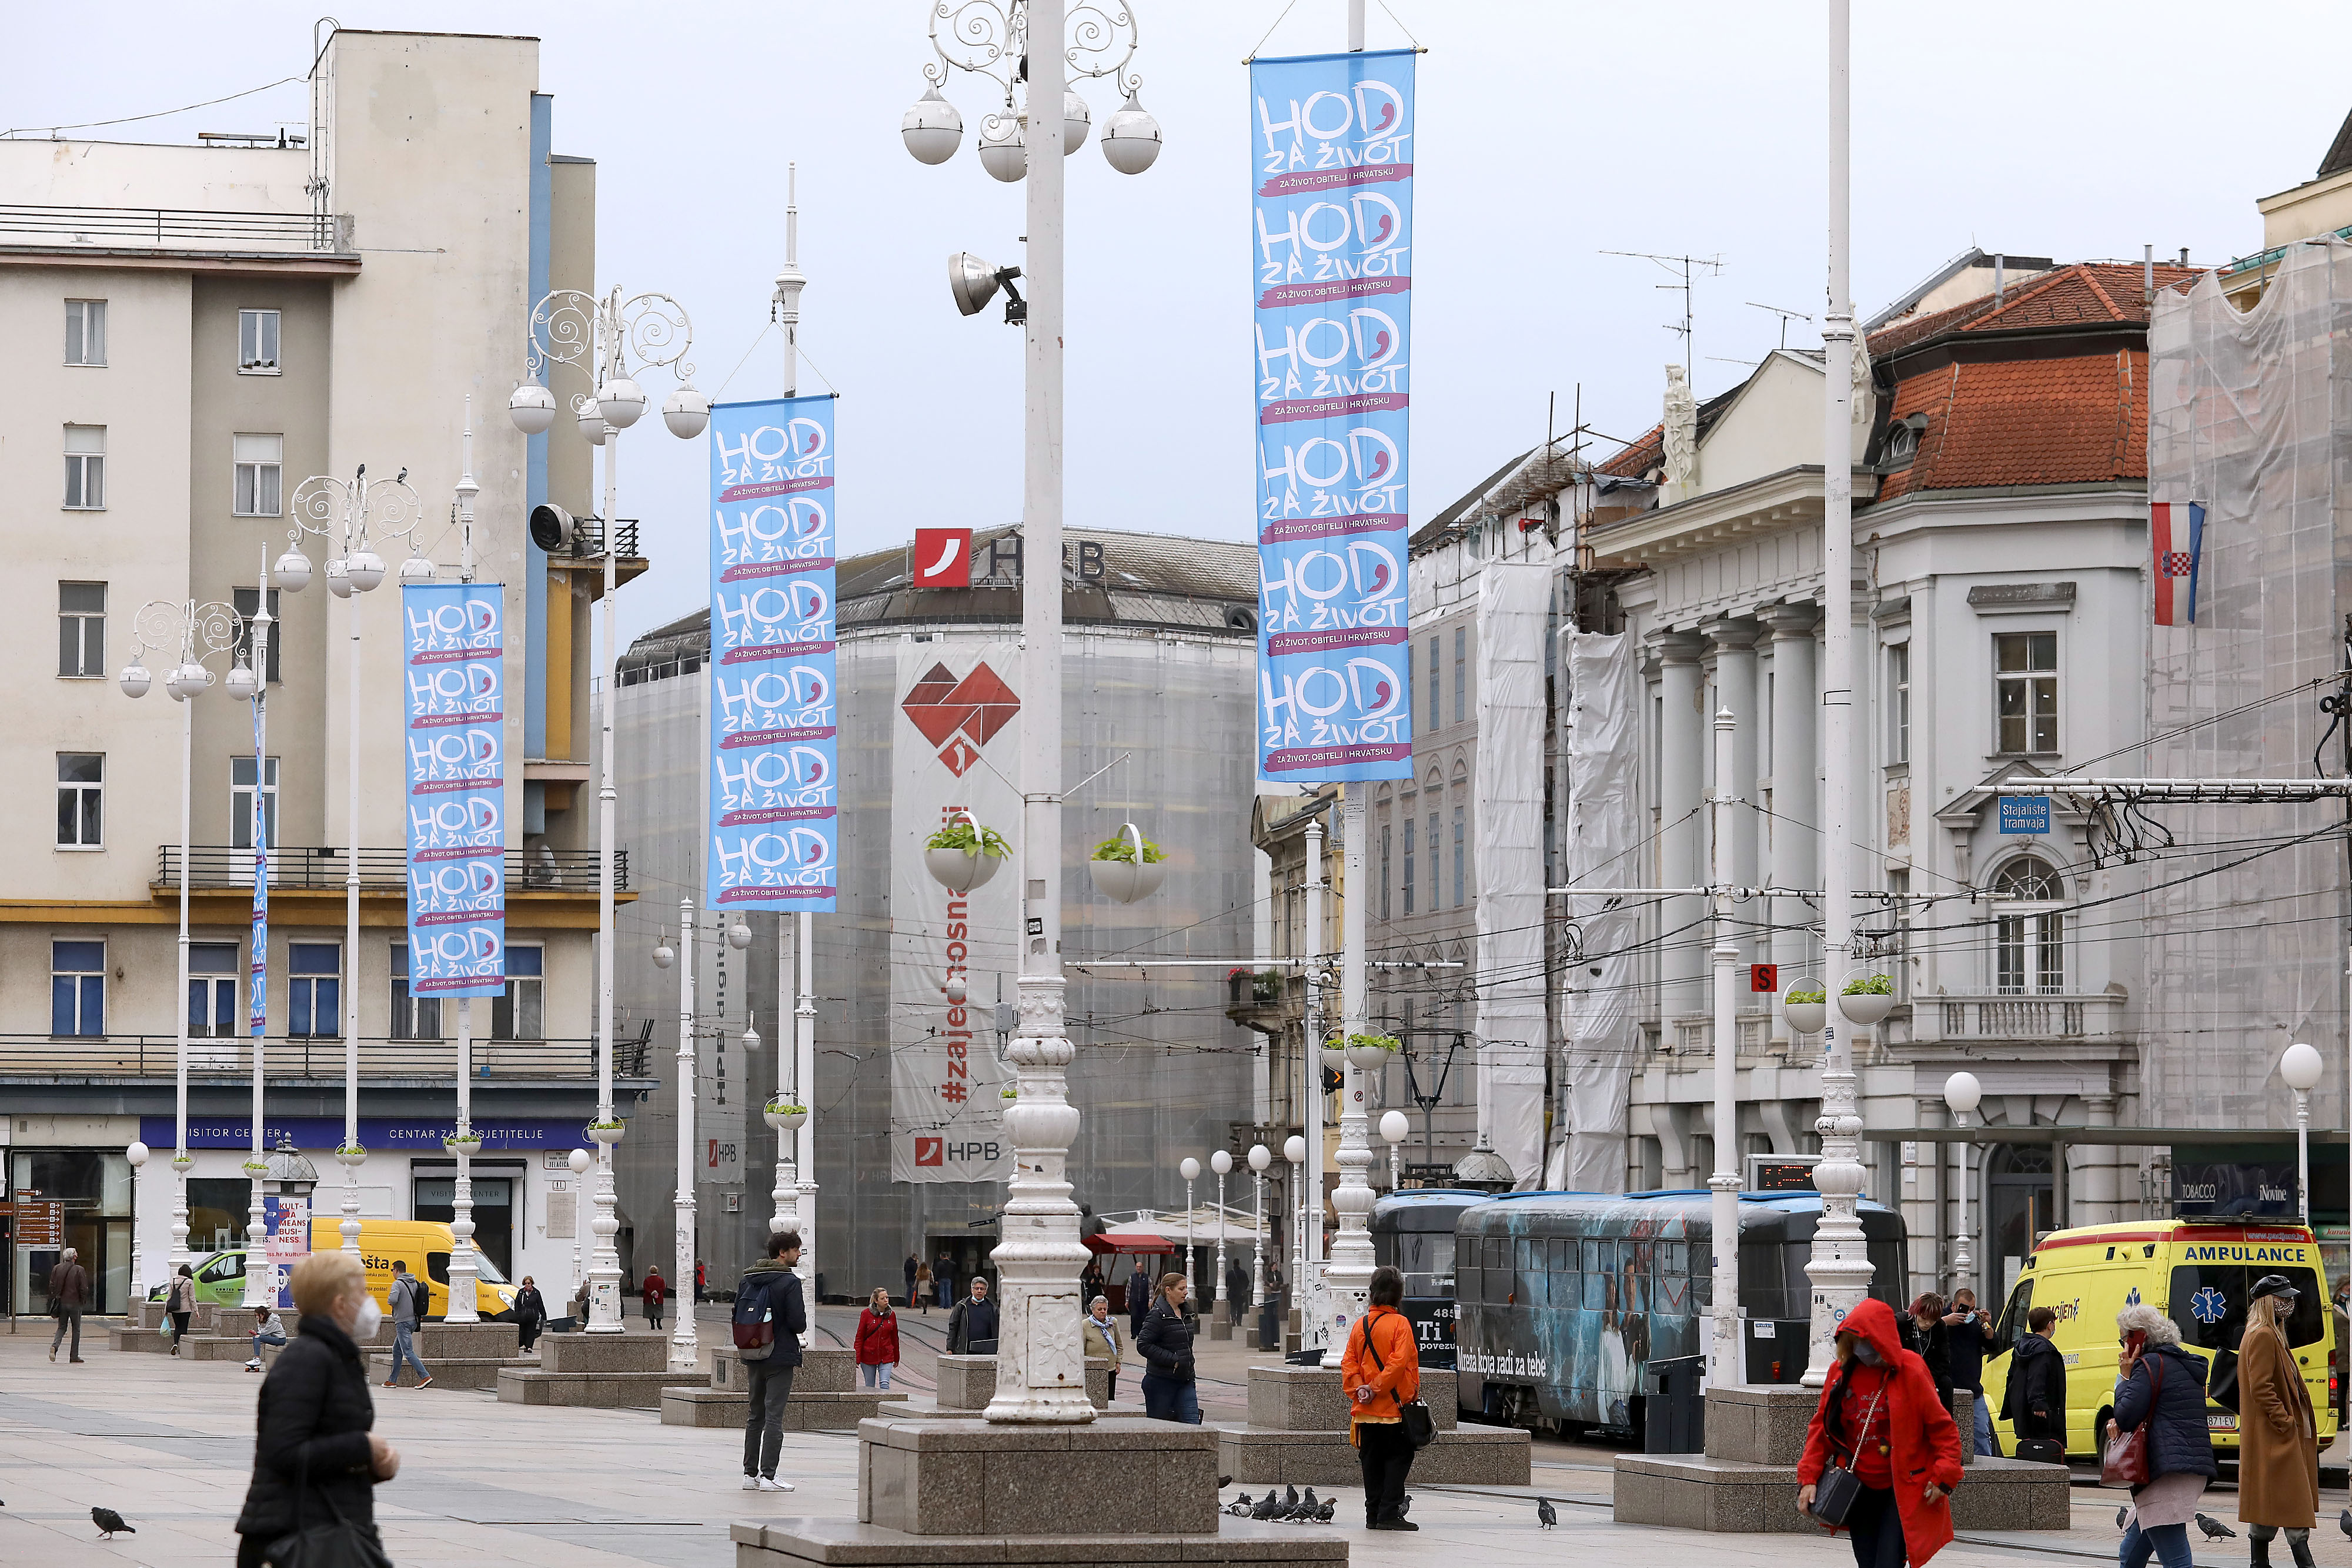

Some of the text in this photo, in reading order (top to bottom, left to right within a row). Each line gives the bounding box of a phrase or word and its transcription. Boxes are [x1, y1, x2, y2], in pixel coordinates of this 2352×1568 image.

[1258, 80, 1404, 151] HOD
[1263, 133, 1412, 173] ZA ŽIVOT
[1316, 173, 1347, 183] OBITELJ
[1353, 168, 1394, 179] HRVATSKU
[1256, 192, 1402, 263] HOD
[1258, 247, 1411, 285] ZA ŽIVOT
[1314, 285, 1345, 296] OBITELJ
[1351, 280, 1391, 292] HRVATSKU
[1255, 307, 1400, 378] HOD
[1259, 363, 1408, 400] ZA ŽIVOT
[1312, 402, 1344, 412] OBITELJ
[1350, 397, 1389, 409] HRVATSKU
[716, 418, 826, 470] HOD
[721, 455, 833, 485] ZA ŽIVOT
[1259, 427, 1399, 499] HOD
[1262, 483, 1406, 519] ZA ŽIVOT
[716, 497, 827, 549] HOD
[1312, 522, 1343, 531] OBITELJ
[1349, 517, 1389, 528] HRVATSKU
[721, 536, 833, 565] ZA ŽIVOT
[990, 539, 1105, 580] HB
[1258, 541, 1399, 611] HOD
[407, 600, 496, 639] HOD
[717, 580, 827, 632] HOD
[1265, 597, 1406, 633] ZA ŽIVOT
[412, 631, 501, 651] ZA ŽIVOT
[722, 620, 834, 647] ZA ŽIVOT
[1311, 635, 1342, 644] OBITELJ
[1348, 630, 1390, 641] HRVATSKU
[407, 664, 497, 703] HOD
[717, 666, 828, 717] HOD
[1261, 657, 1401, 727] HOD
[412, 696, 502, 715] ZA ŽIVOT
[722, 705, 834, 732] ZA ŽIVOT
[1264, 713, 1407, 748] ZA ŽIVOT
[408, 730, 497, 768] HOD
[1311, 751, 1343, 761] OBITELJ
[1349, 747, 1392, 758] HRVATSKU
[413, 762, 502, 781] ZA ŽIVOT
[716, 746, 829, 797] HOD
[721, 785, 835, 810] ZA ŽIVOT
[2003, 804, 2046, 818] Stajalište
[410, 797, 498, 837] HOD
[2004, 817, 2045, 831] tramvaja
[414, 830, 502, 849] ZA ŽIVOT
[715, 827, 829, 872] HOD
[411, 861, 499, 901] HOD
[719, 865, 835, 887] ZA ŽIVOT
[416, 894, 503, 912] ZA ŽIVOT
[412, 927, 499, 966] HOD
[415, 959, 503, 978] ZA ŽIVOT
[1758, 967, 1771, 990] S
[186, 1128, 280, 1138] ISITOR CEER
[389, 1129, 436, 1139] CENTAR
[470, 1129, 543, 1139] OSJETITELJE
[718, 1144, 737, 1162] HPB
[948, 1142, 1001, 1161] HPB
[2182, 1183, 2216, 1199] TOBACCO
[2259, 1184, 2287, 1201] iNovine
[2185, 1247, 2306, 1262] AMBULANCE
[1417, 1321, 1441, 1341] Ti
[1419, 1343, 1455, 1351] povezu
[2063, 1353, 2079, 1364] RIJEVOZ
[1456, 1346, 1547, 1380] Mreža koja radi za tebe
